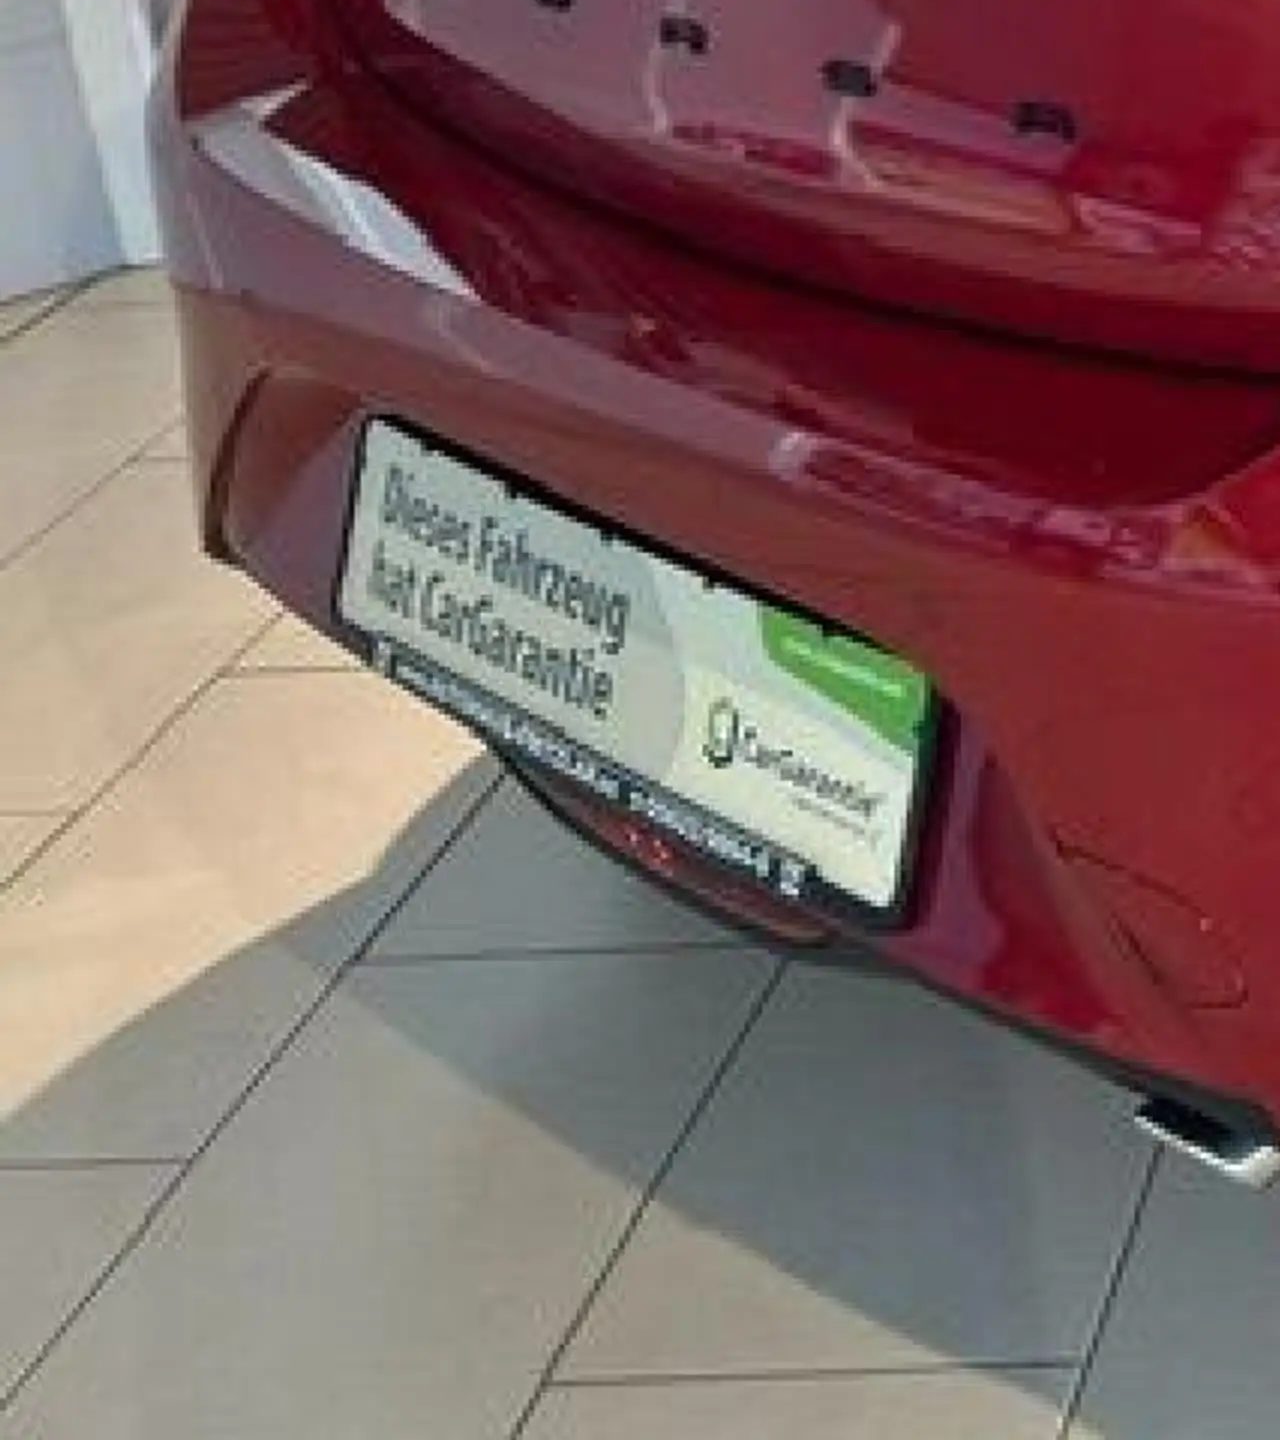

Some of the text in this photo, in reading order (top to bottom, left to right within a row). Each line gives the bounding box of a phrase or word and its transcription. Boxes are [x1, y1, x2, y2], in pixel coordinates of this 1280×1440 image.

[366, 538, 614, 721] hat CarGarantie
[384, 462, 631, 656] Dieses Fahrzeug
